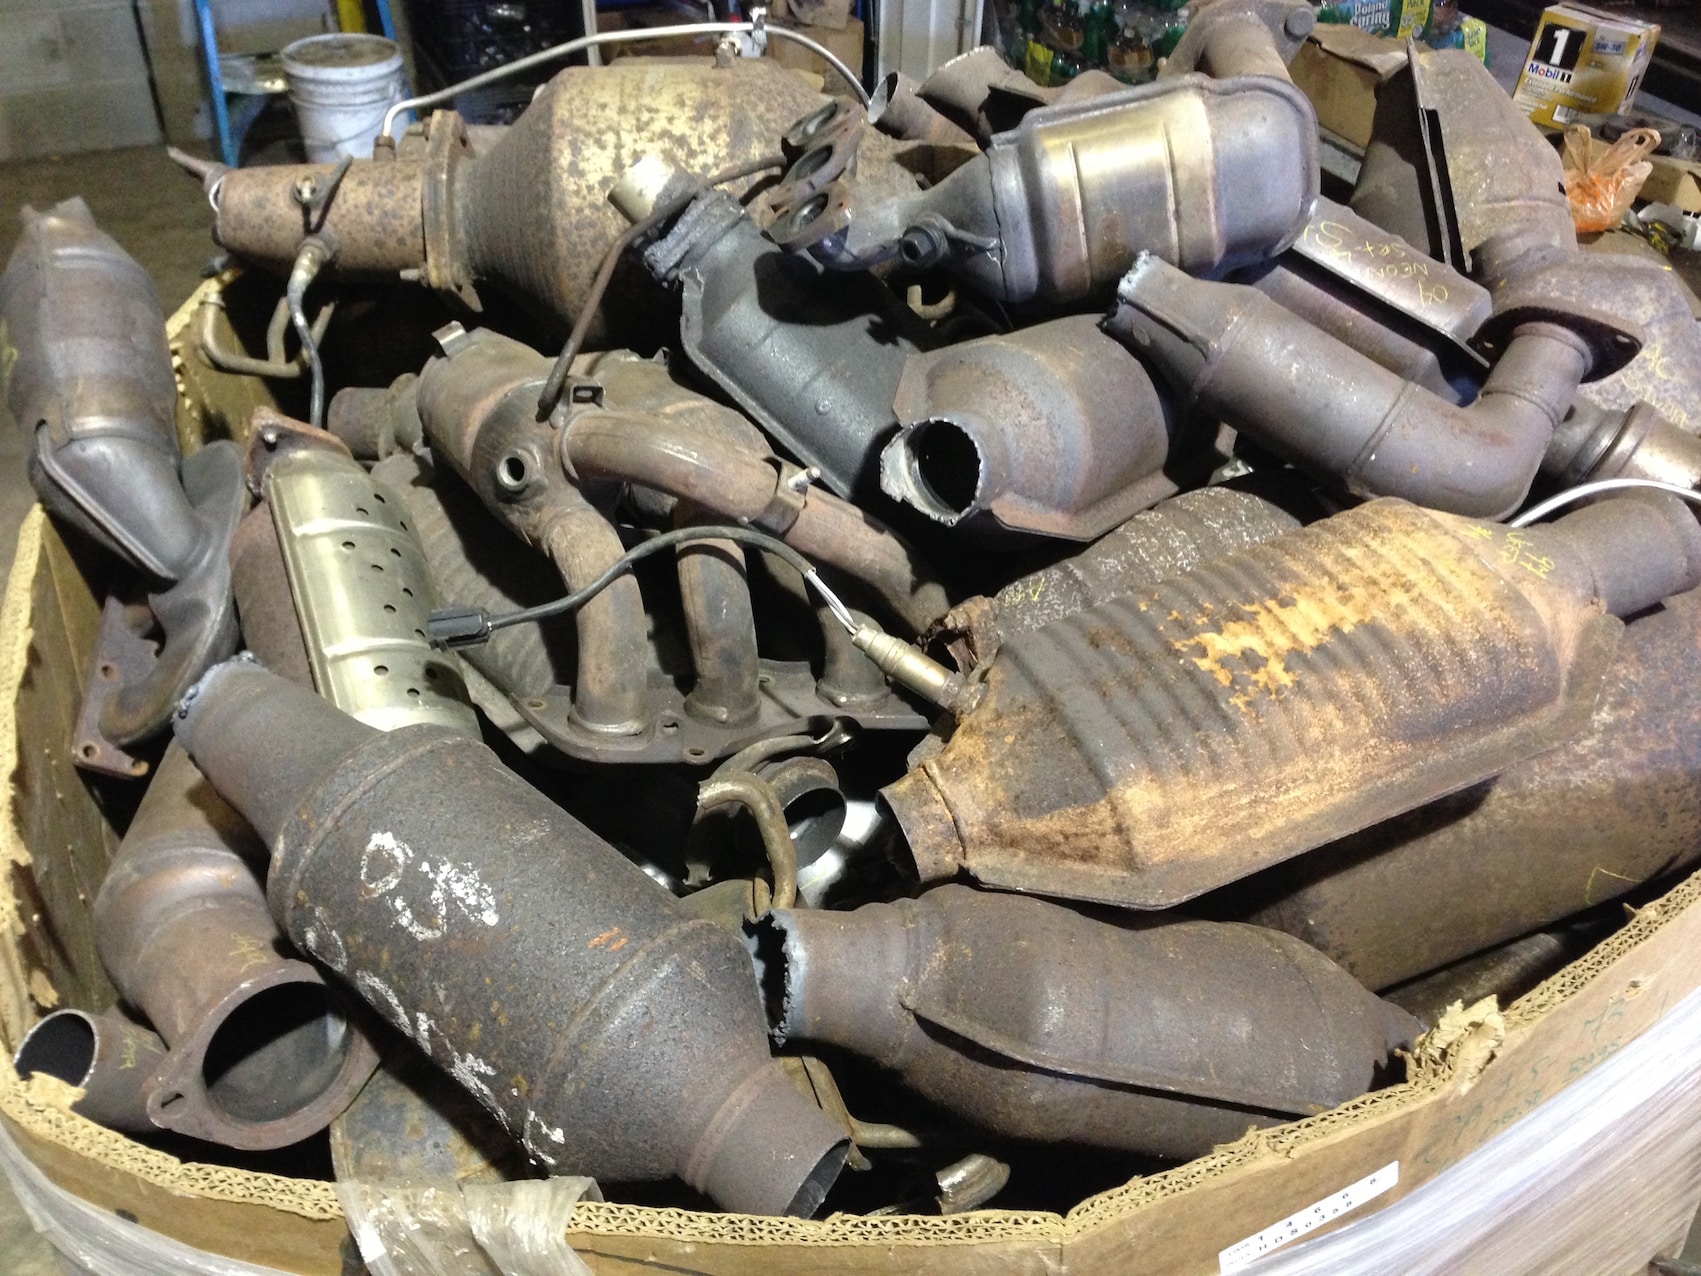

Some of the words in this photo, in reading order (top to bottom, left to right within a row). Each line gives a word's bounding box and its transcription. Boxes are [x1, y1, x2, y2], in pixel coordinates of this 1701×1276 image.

[1549, 28, 1571, 66] 1
[1528, 63, 1560, 80] Mobil
[1366, 262, 1429, 280] NEON
